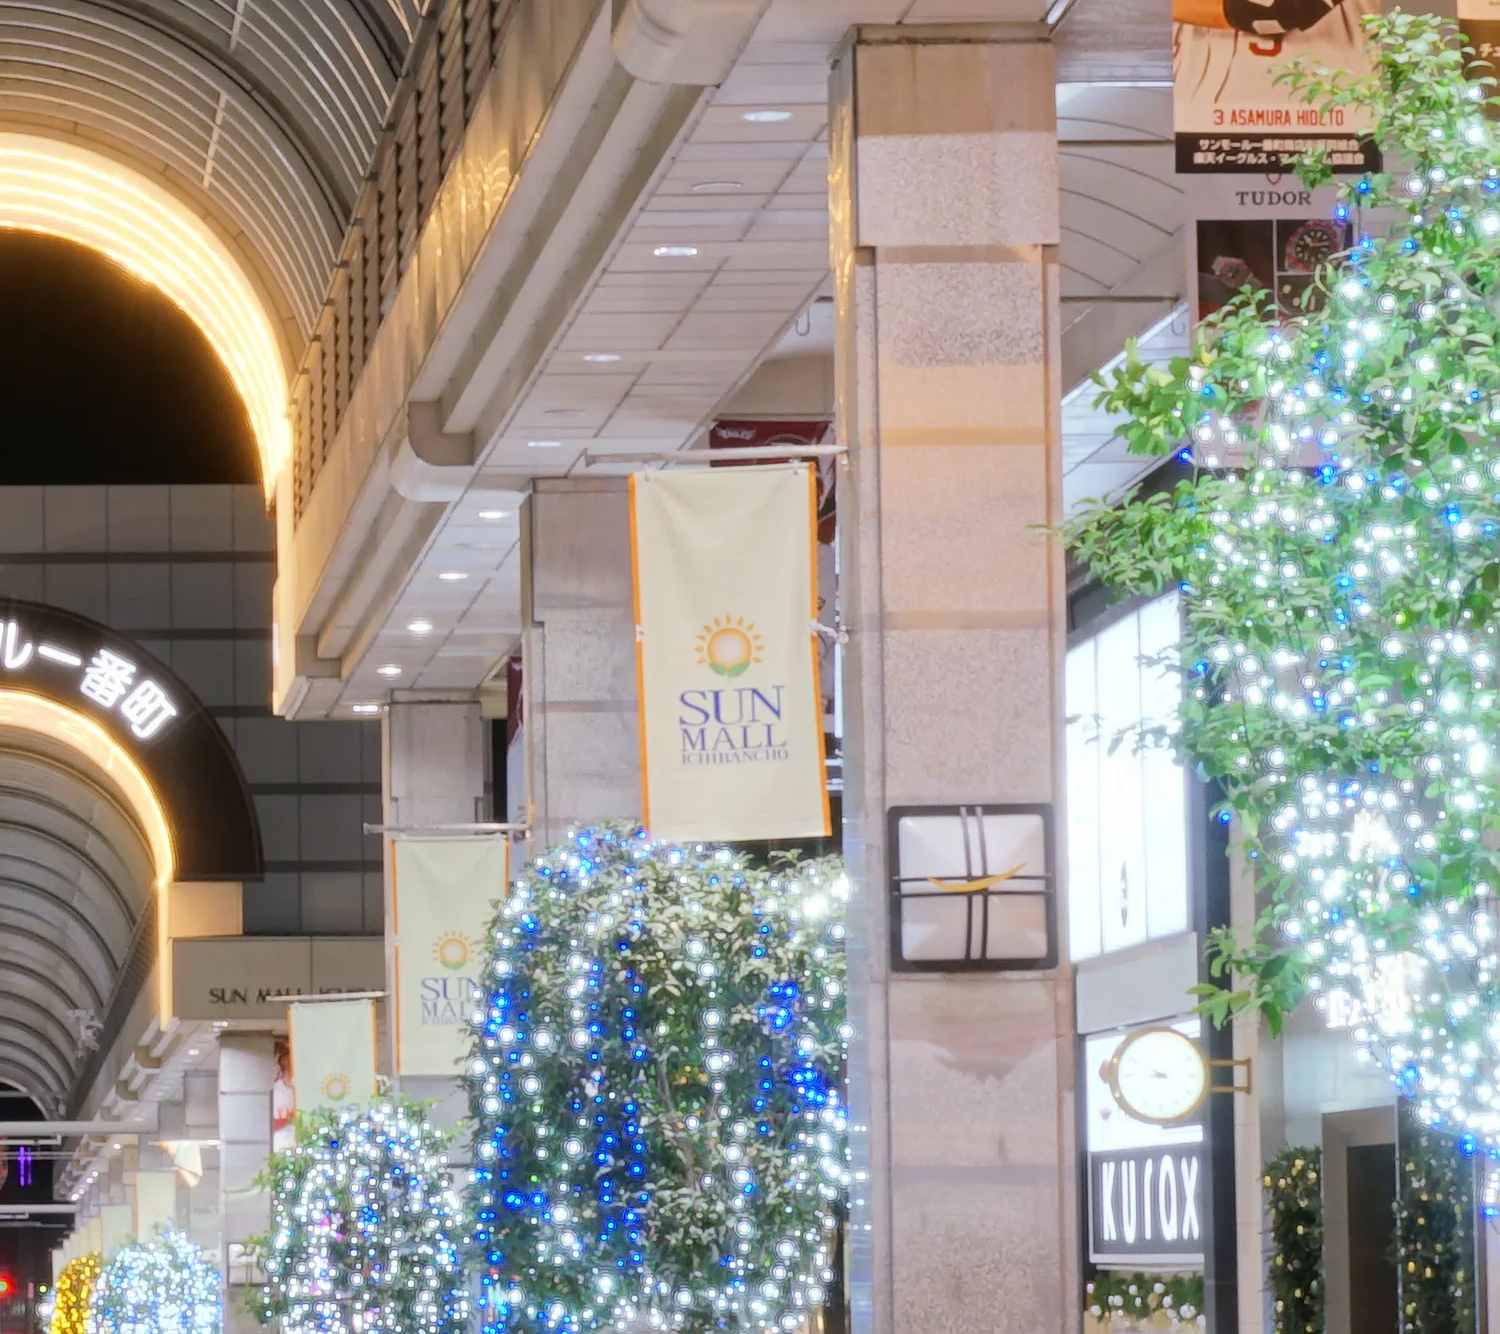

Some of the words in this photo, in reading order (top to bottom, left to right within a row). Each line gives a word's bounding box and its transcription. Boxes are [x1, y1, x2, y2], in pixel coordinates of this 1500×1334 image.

[1212, 109, 1224, 126] 3
[1230, 109, 1291, 126] ASAMURA
[1235, 191, 1312, 207] TUDOR
[679, 685, 785, 727] SUN
[680, 723, 788, 751] MALL
[681, 748, 789, 765] ICHIBANCHO
[208, 987, 248, 1004] SUN
